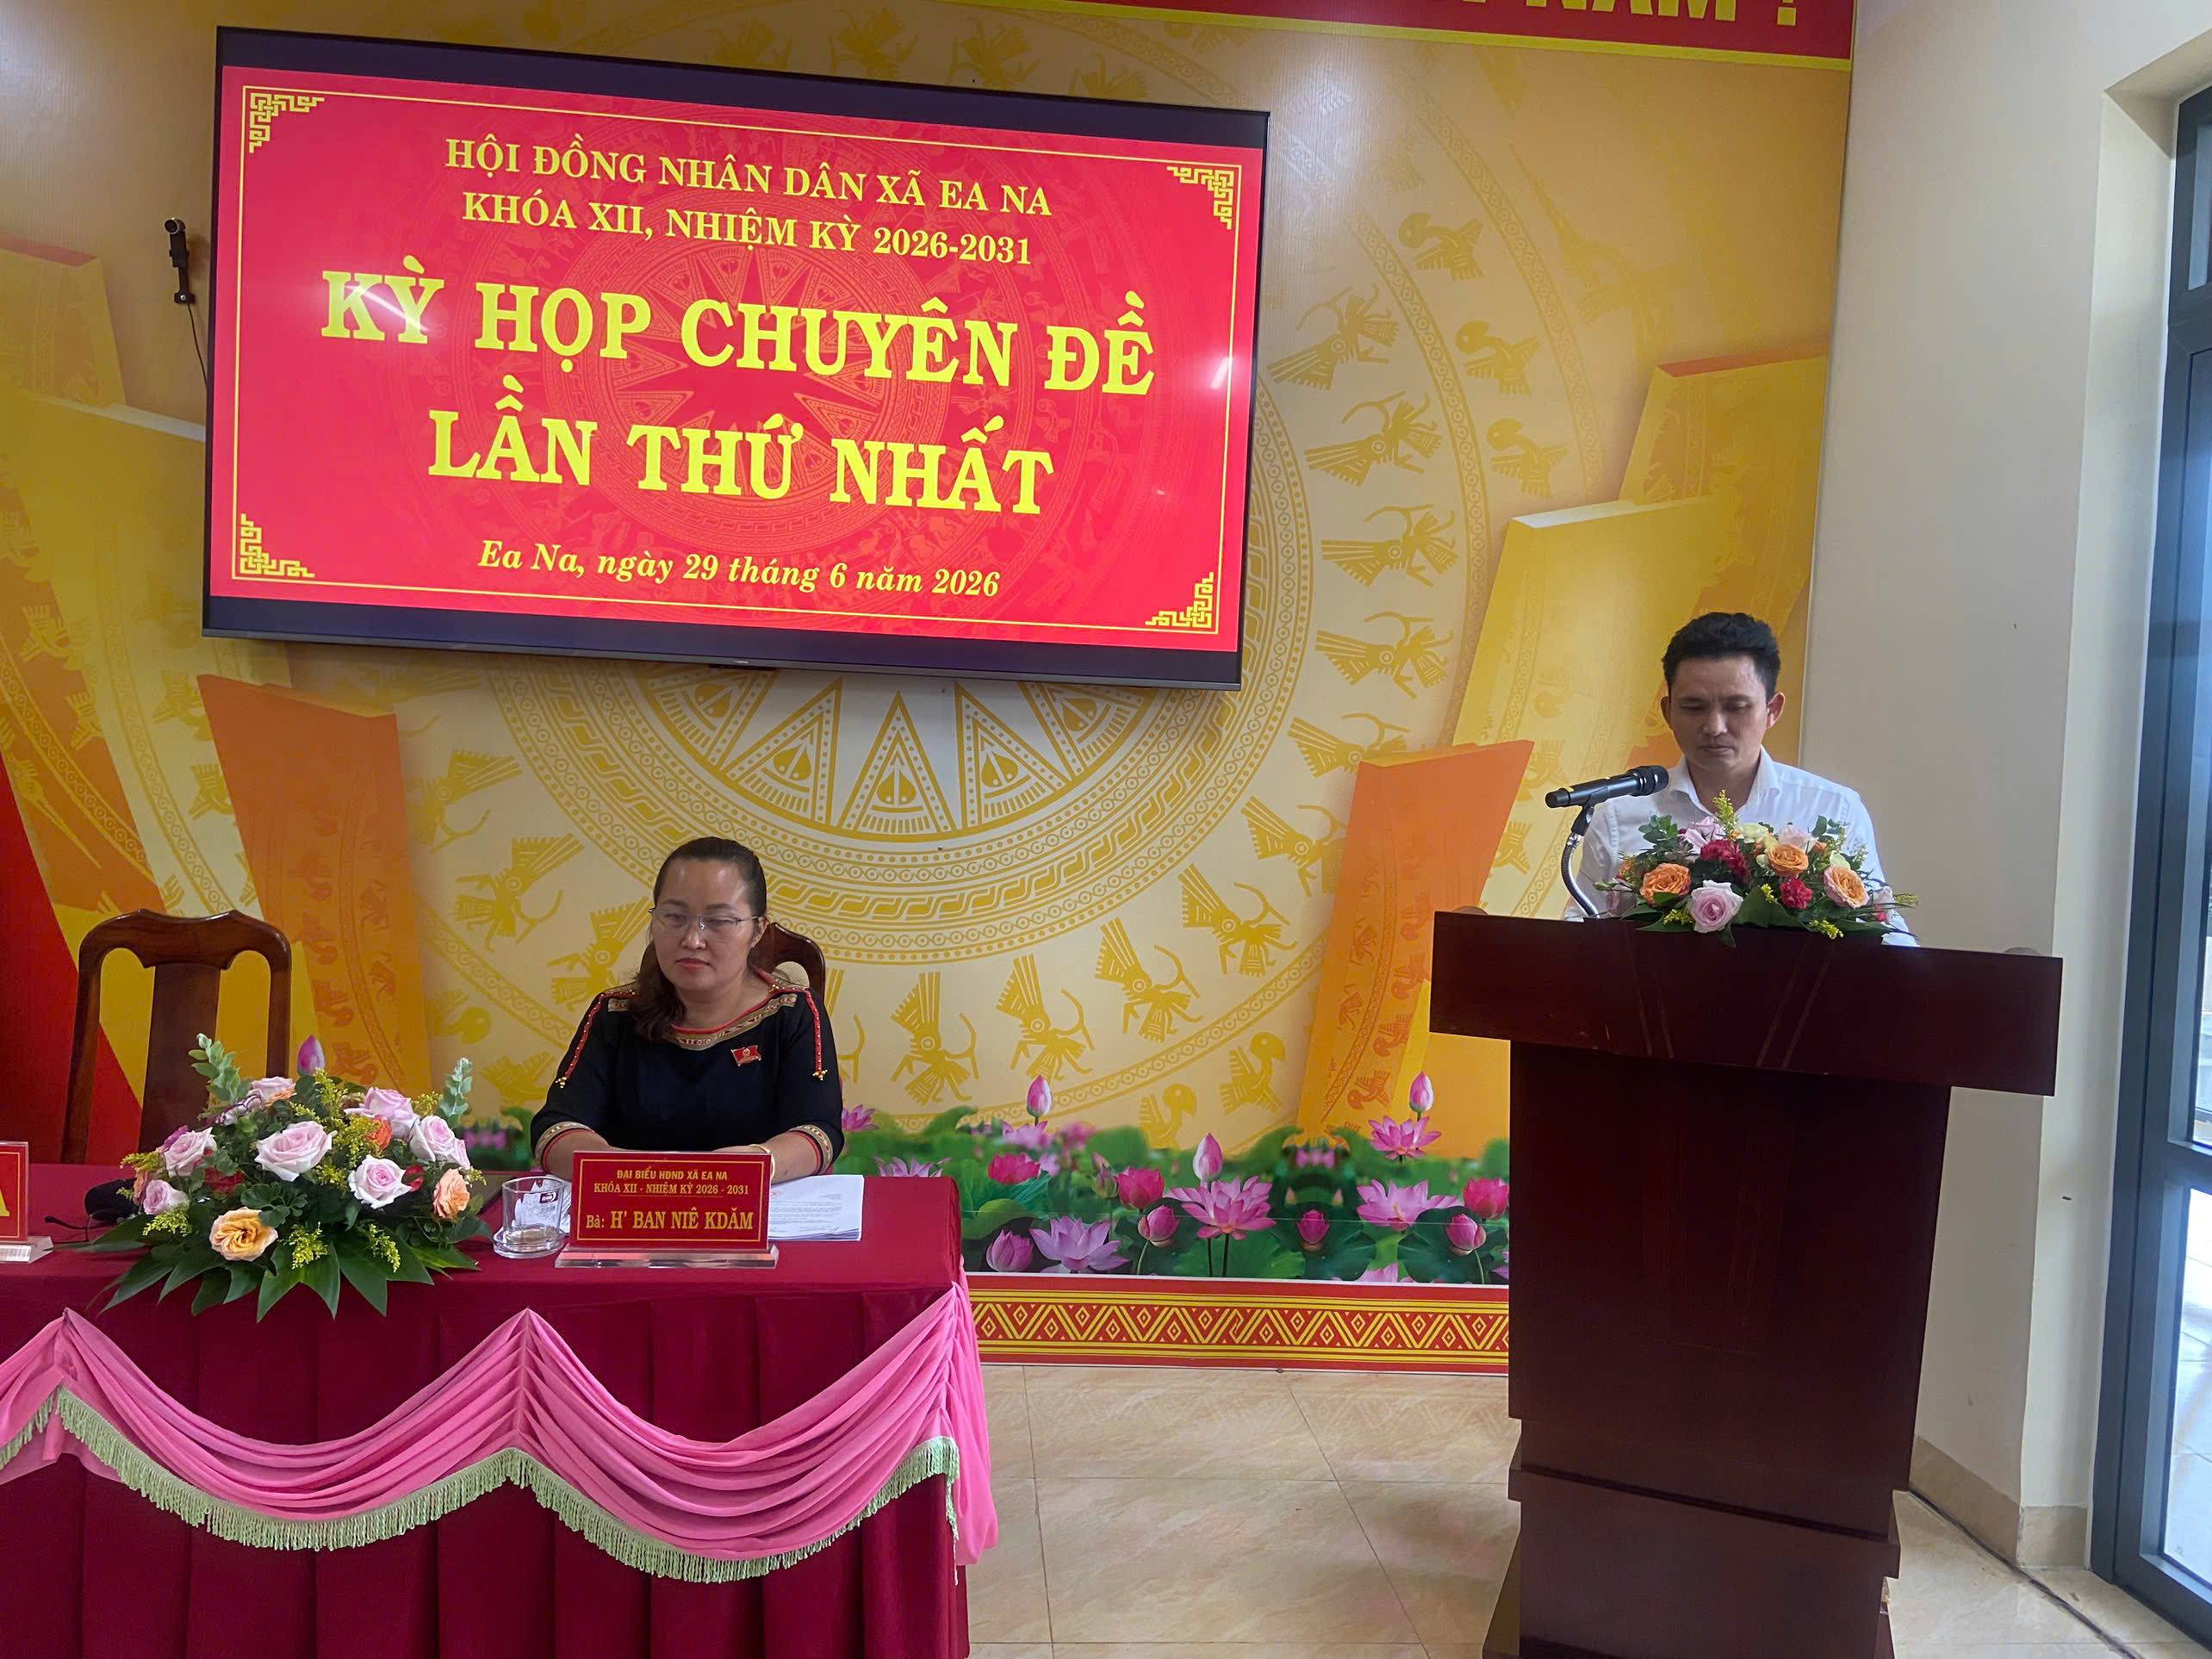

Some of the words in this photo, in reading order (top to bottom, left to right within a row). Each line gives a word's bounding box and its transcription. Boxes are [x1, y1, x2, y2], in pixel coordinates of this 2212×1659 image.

[445, 134, 520, 178] HỘI
[533, 134, 646, 183] ĐỒNG
[659, 153, 773, 194] NHÂN
[783, 162, 867, 202] DÂN
[876, 169, 926, 207] XÃ
[939, 181, 989, 211] EA
[1000, 185, 1053, 216] NA
[463, 189, 577, 229] KHÓA
[588, 202, 653, 241] XII,
[666, 207, 798, 252] NHIỆM
[809, 214, 862, 252] KỲ
[873, 227, 1032, 265] 2026-2031
[320, 254, 444, 345] KỲ
[475, 283, 651, 373] HỌP
[680, 296, 1018, 387] CHUYÊN
[1044, 290, 1155, 395] ĐỀ
[428, 375, 598, 486] LẦN
[625, 413, 805, 500] THỨ
[829, 415, 1054, 515] NHẤT
[477, 539, 523, 569] Ea
[530, 543, 585, 579] Na,
[597, 550, 674, 585] ngày
[682, 553, 719, 581] 29
[728, 557, 820, 593] tháng
[830, 562, 848, 588] 6
[855, 565, 923, 593] năm
[931, 568, 1001, 597] 2026
[593, 1181, 621, 1193] KHÓA
[623, 1184, 637, 1194] XII
[646, 1181, 677, 1196] NHIỆM
[696, 1184, 718, 1195] 2026
[726, 1185, 749, 1196] 2031
[617, 1170, 632, 1181] ĐẠI
[635, 1165, 656, 1179] BIỂU
[687, 1168, 699, 1180] XÃ
[701, 1171, 713, 1180] EA
[716, 1171, 728, 1181] NA
[586, 1215, 605, 1228] Bà:
[632, 1211, 666, 1229] BAN
[671, 1207, 699, 1229] NIÊ
[704, 1207, 755, 1230] KDĂM
